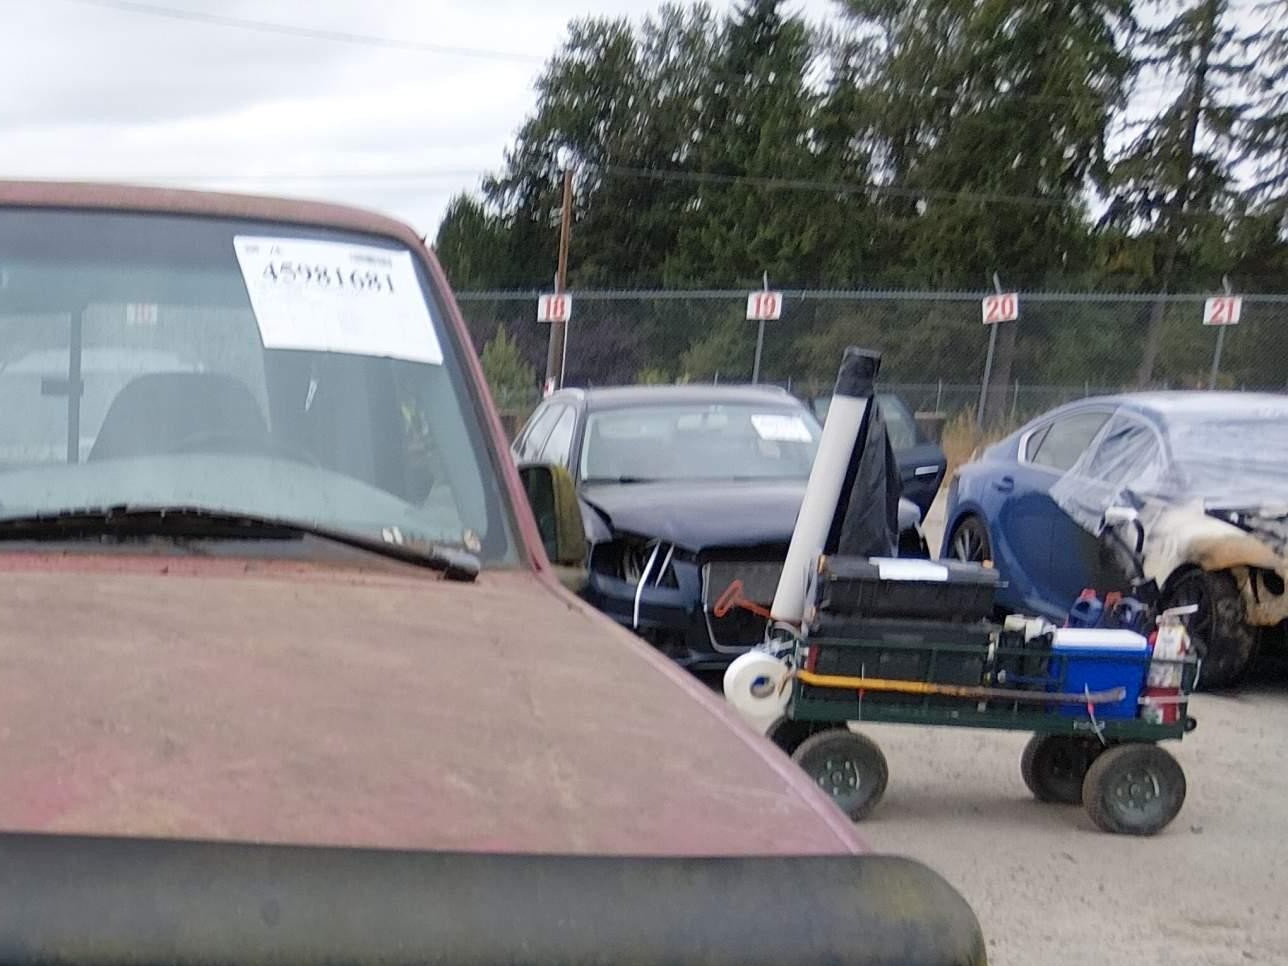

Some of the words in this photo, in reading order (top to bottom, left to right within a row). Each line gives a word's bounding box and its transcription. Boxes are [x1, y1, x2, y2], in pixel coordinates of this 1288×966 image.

[262, 261, 396, 295] 45981681
[546, 296, 565, 321] 18
[755, 294, 776, 320] 19
[987, 295, 1015, 320] 20
[1209, 297, 1235, 323] 21
